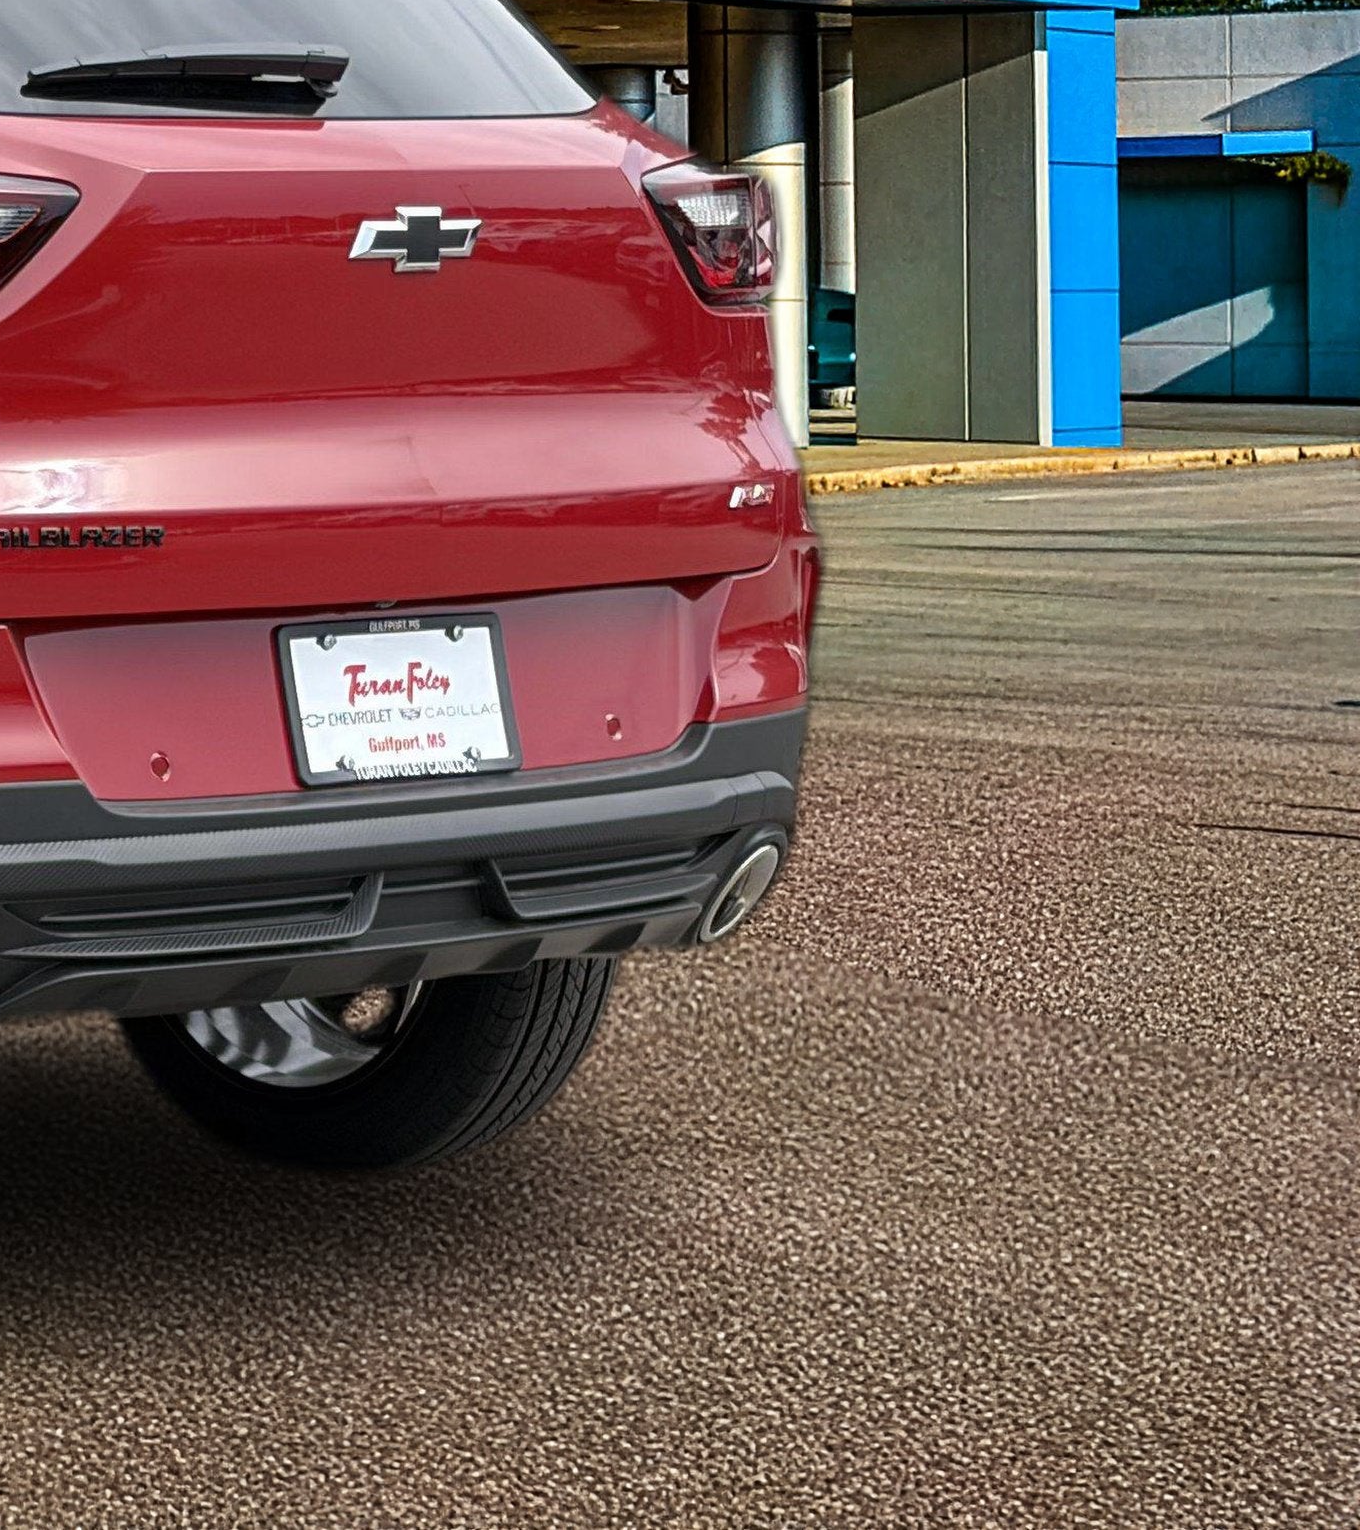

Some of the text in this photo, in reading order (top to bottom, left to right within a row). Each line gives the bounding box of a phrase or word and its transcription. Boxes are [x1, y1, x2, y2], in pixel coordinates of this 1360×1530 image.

[328, 703, 500, 726] CHEVROLET CADILLAC
[368, 732, 447, 754] Gulfport, MS
